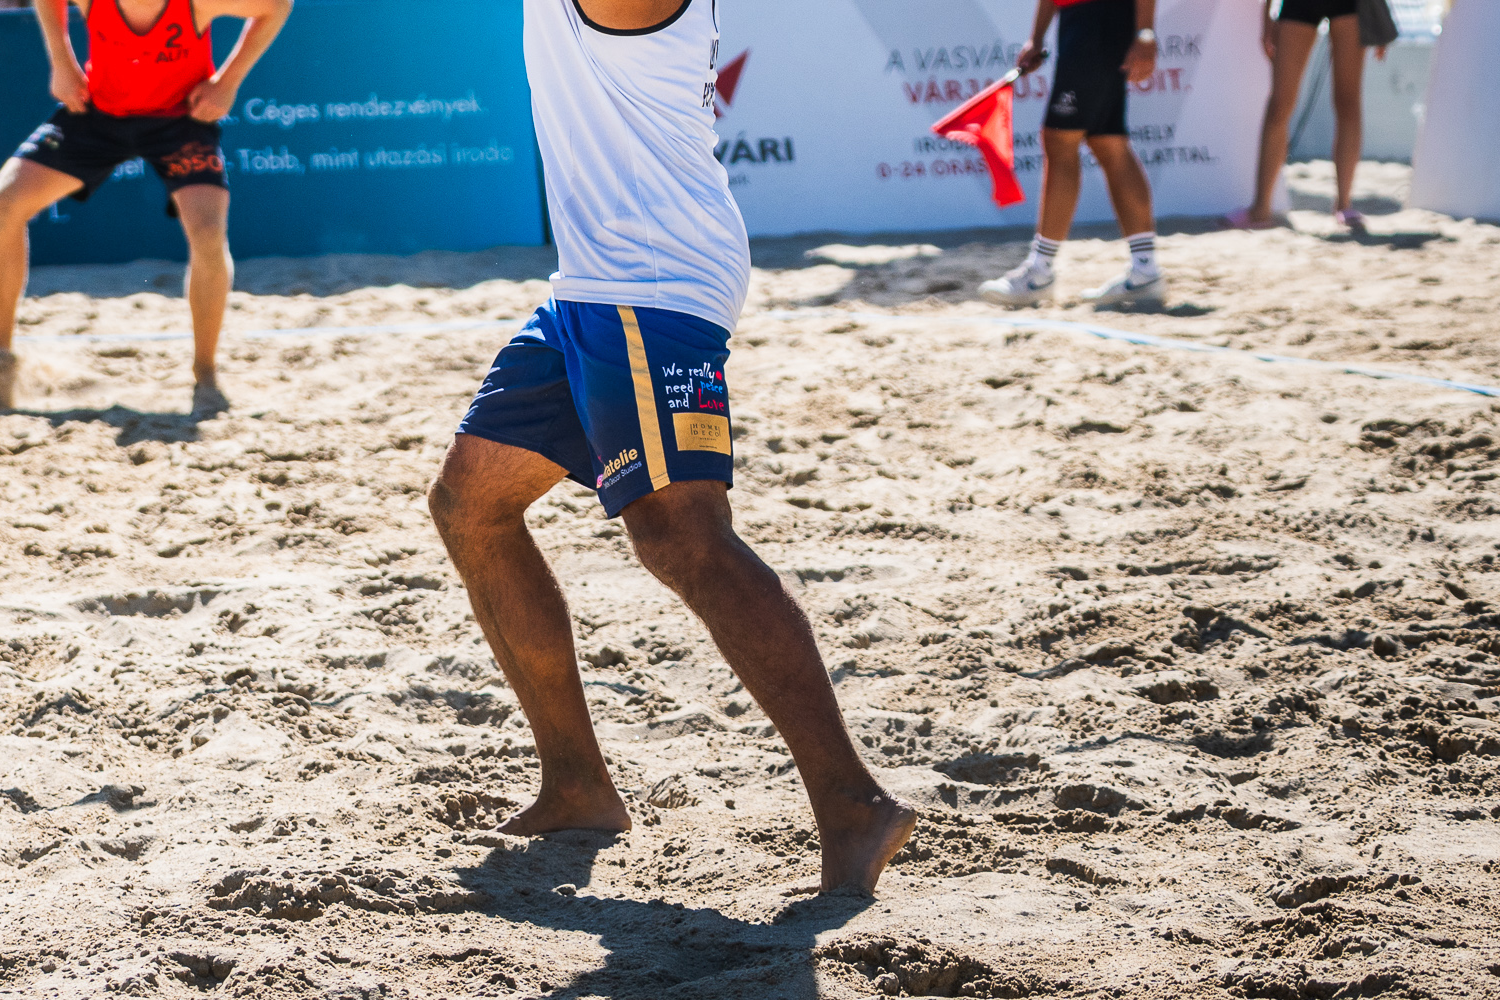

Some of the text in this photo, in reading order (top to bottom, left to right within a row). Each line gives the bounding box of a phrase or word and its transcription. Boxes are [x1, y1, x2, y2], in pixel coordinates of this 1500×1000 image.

[165, 23, 183, 48] 2
[885, 49, 905, 72] A
[310, 147, 360, 169] mint
[713, 129, 796, 165] VÁRI
[662, 362, 715, 384] We really
[665, 377, 723, 394] need peace
[668, 388, 724, 411] and Love
